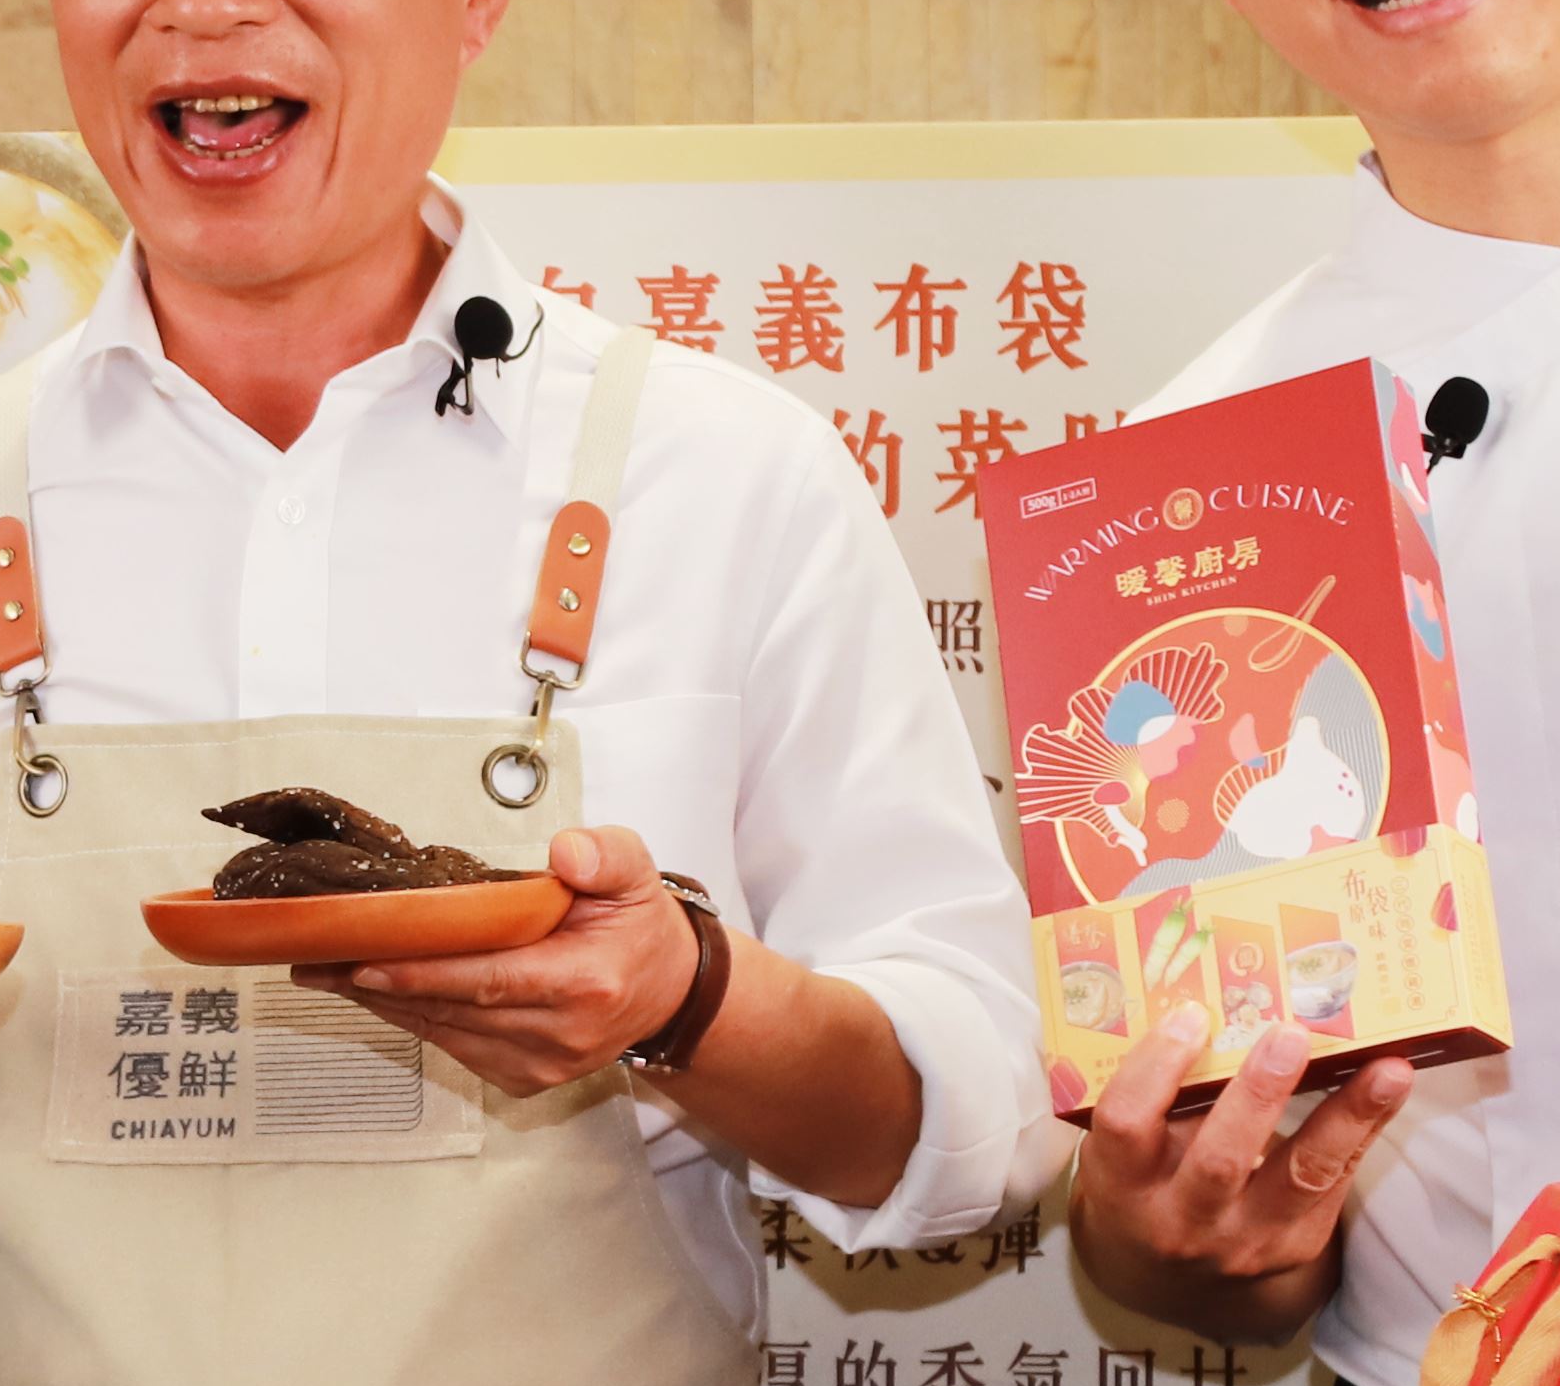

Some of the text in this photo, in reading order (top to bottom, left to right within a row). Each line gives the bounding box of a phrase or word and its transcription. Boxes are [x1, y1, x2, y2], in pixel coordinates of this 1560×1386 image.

[1026, 495, 1057, 512] 500g
[1024, 482, 1356, 603] WARMING CUISINE
[1114, 535, 1262, 599] 暖馨廚房
[1180, 575, 1238, 599] KITCHEN
[115, 988, 240, 1037] 嘉義
[108, 1049, 238, 1100] 優鮮
[110, 1116, 237, 1141] CHIAYUM
